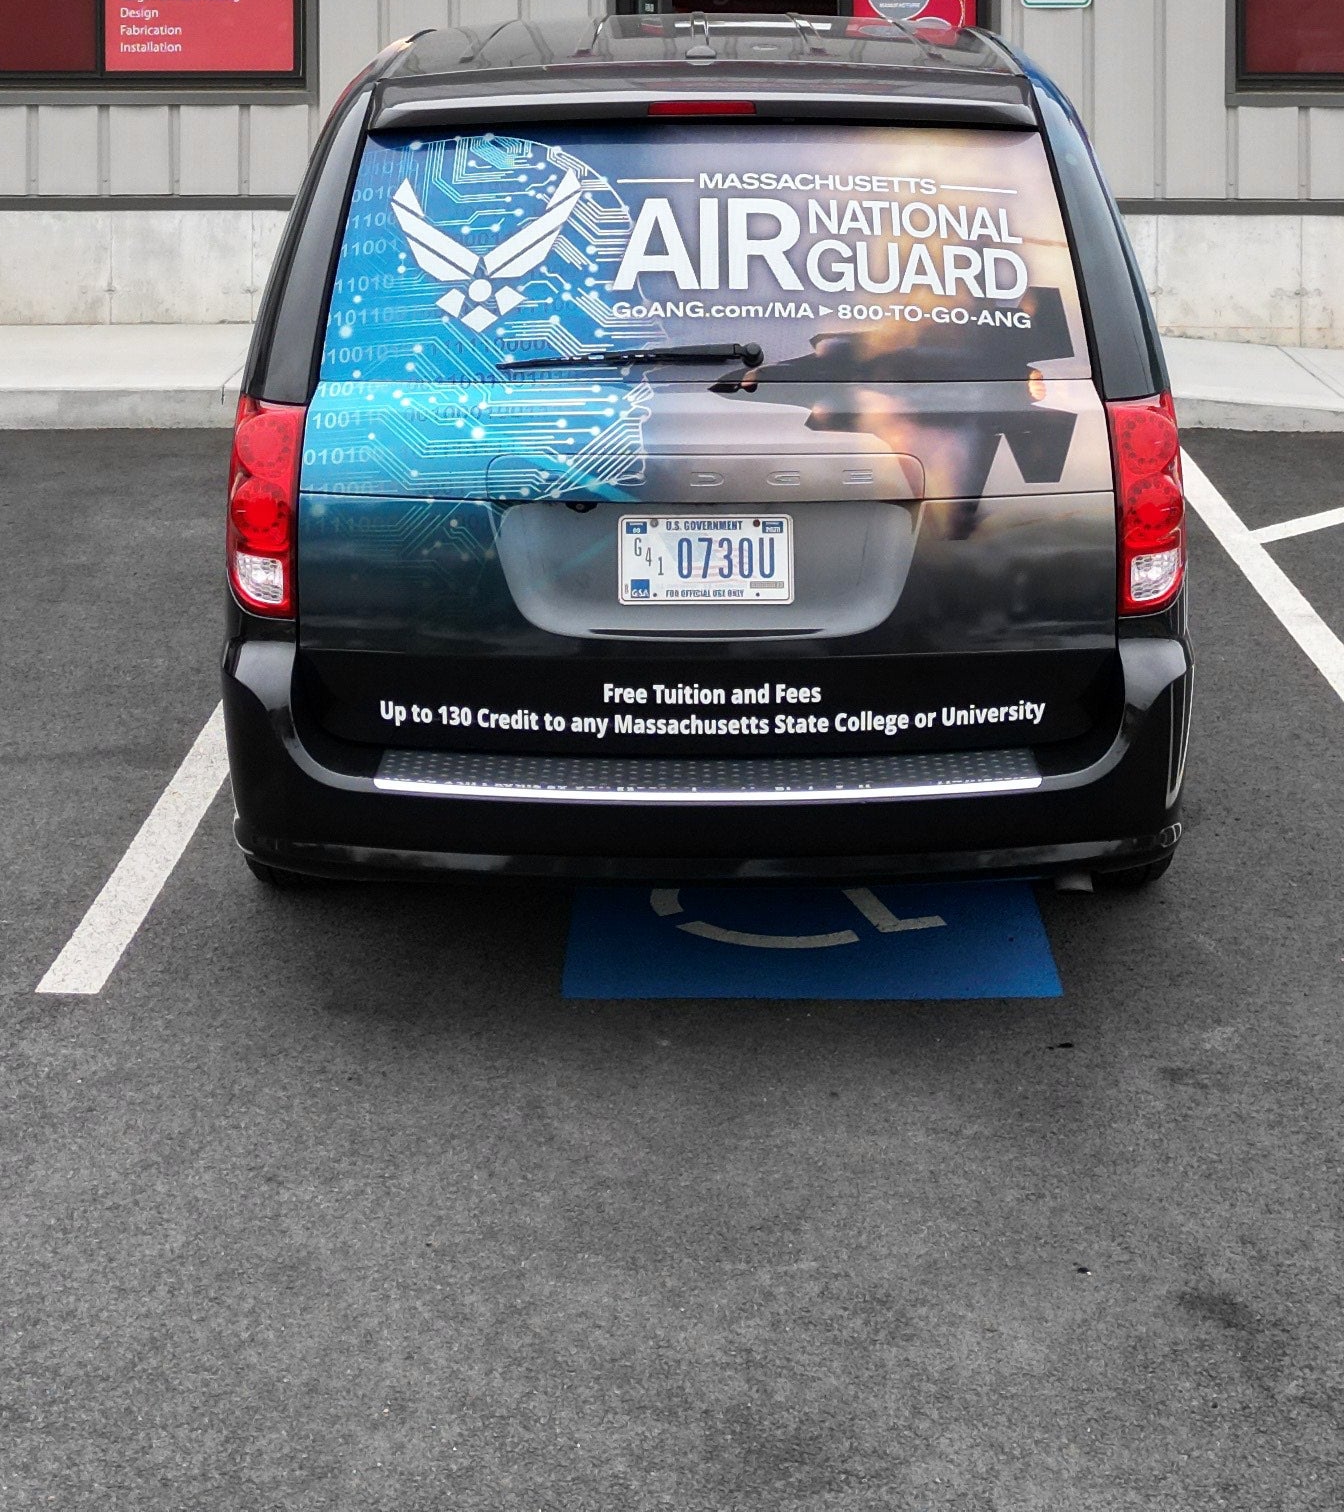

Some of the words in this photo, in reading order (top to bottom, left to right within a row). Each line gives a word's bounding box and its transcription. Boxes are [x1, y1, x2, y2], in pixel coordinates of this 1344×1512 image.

[120, 8, 159, 20] Design
[120, 25, 182, 36] Fabrication
[120, 42, 182, 53] Installation
[699, 172, 937, 195] MASSACHUSETTS
[807, 198, 1023, 245] NATIONAL
[612, 197, 805, 291] AIR
[806, 239, 1028, 300] GUARD
[612, 301, 815, 319] GoANG.com/MA
[837, 304, 1032, 329] 800-TO-GO-ANG
[666, 520, 682, 531] U.S.
[684, 520, 743, 531] GOVERNMENT
[677, 536, 775, 579] 0730U
[603, 683, 648, 703] Free
[653, 683, 726, 704] Tuition
[730, 683, 770, 704] and
[775, 684, 822, 704] Fees
[379, 700, 407, 726] Up
[411, 704, 433, 725] to
[438, 706, 472, 727] 130
[477, 708, 539, 731] Credit
[544, 712, 566, 732] to
[570, 716, 609, 739] any
[614, 714, 770, 735] Massachusetts
[774, 714, 829, 735] State
[834, 710, 909, 736] College
[914, 711, 937, 729] or
[941, 699, 1047, 726] University
